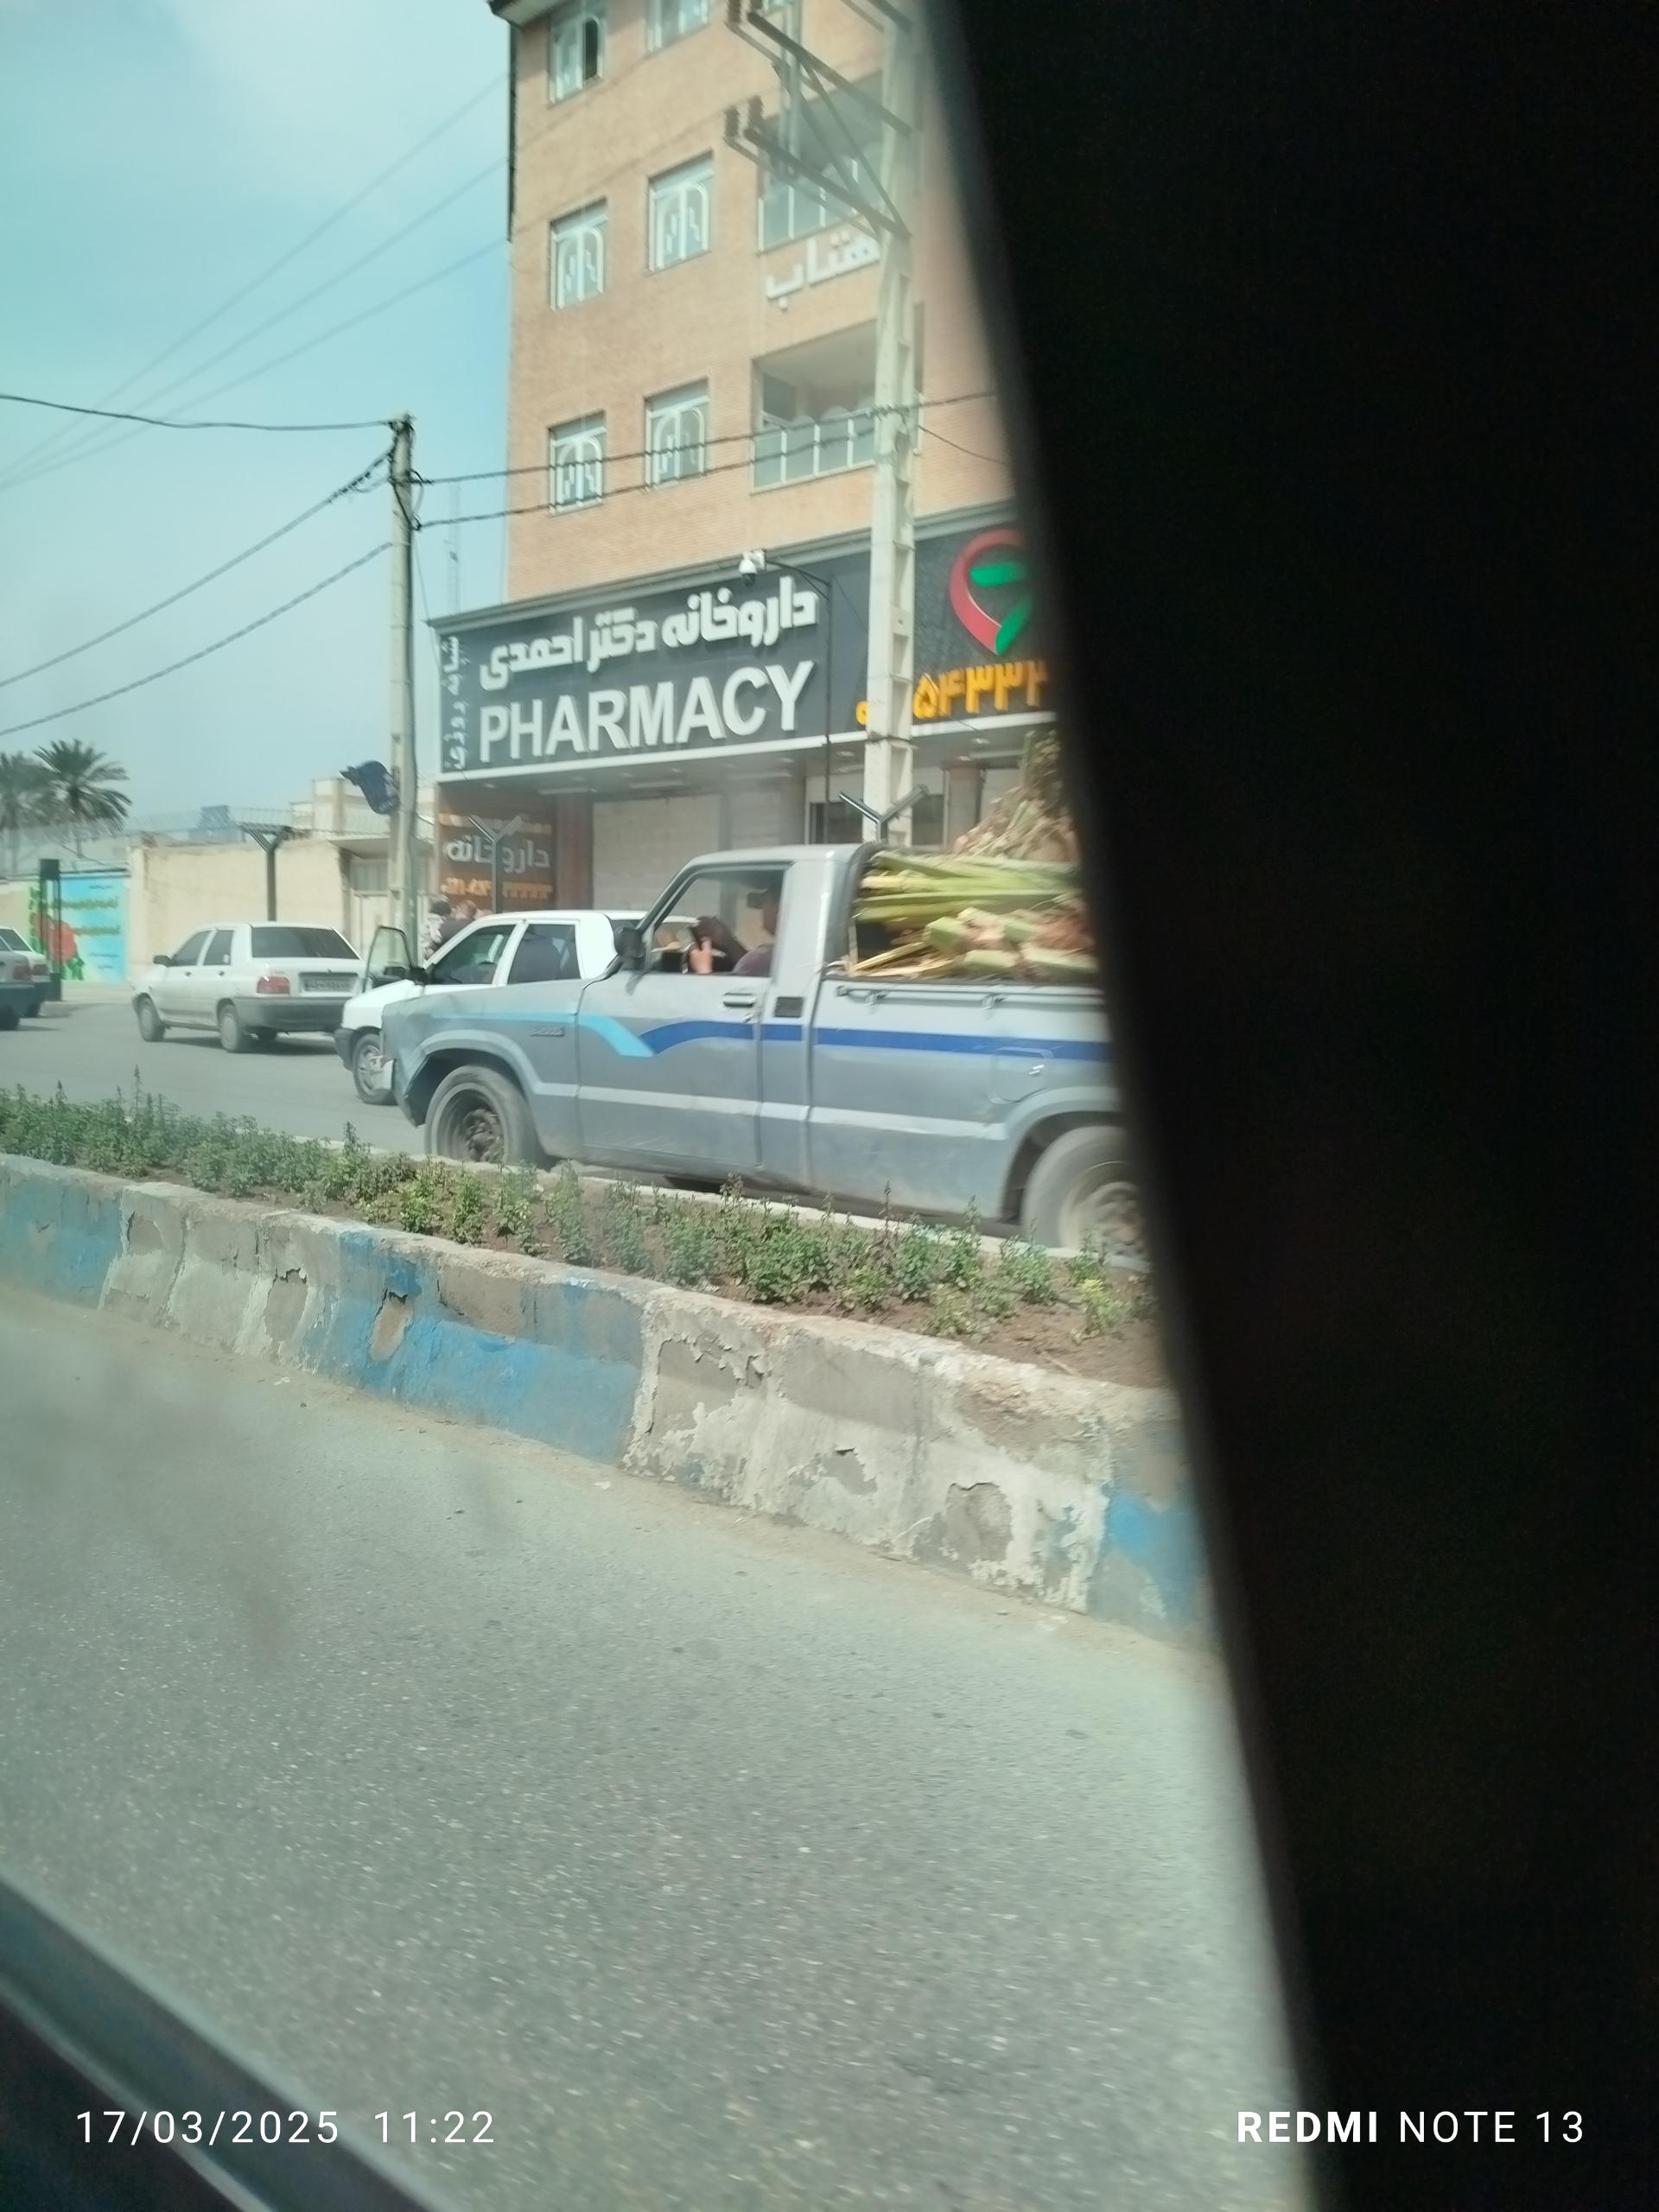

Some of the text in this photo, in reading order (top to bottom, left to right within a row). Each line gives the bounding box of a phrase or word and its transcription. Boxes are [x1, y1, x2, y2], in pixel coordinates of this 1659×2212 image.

[479, 575, 819, 691] داروخانه دکتر احمدی
[479, 659, 816, 765] PHARMACY
